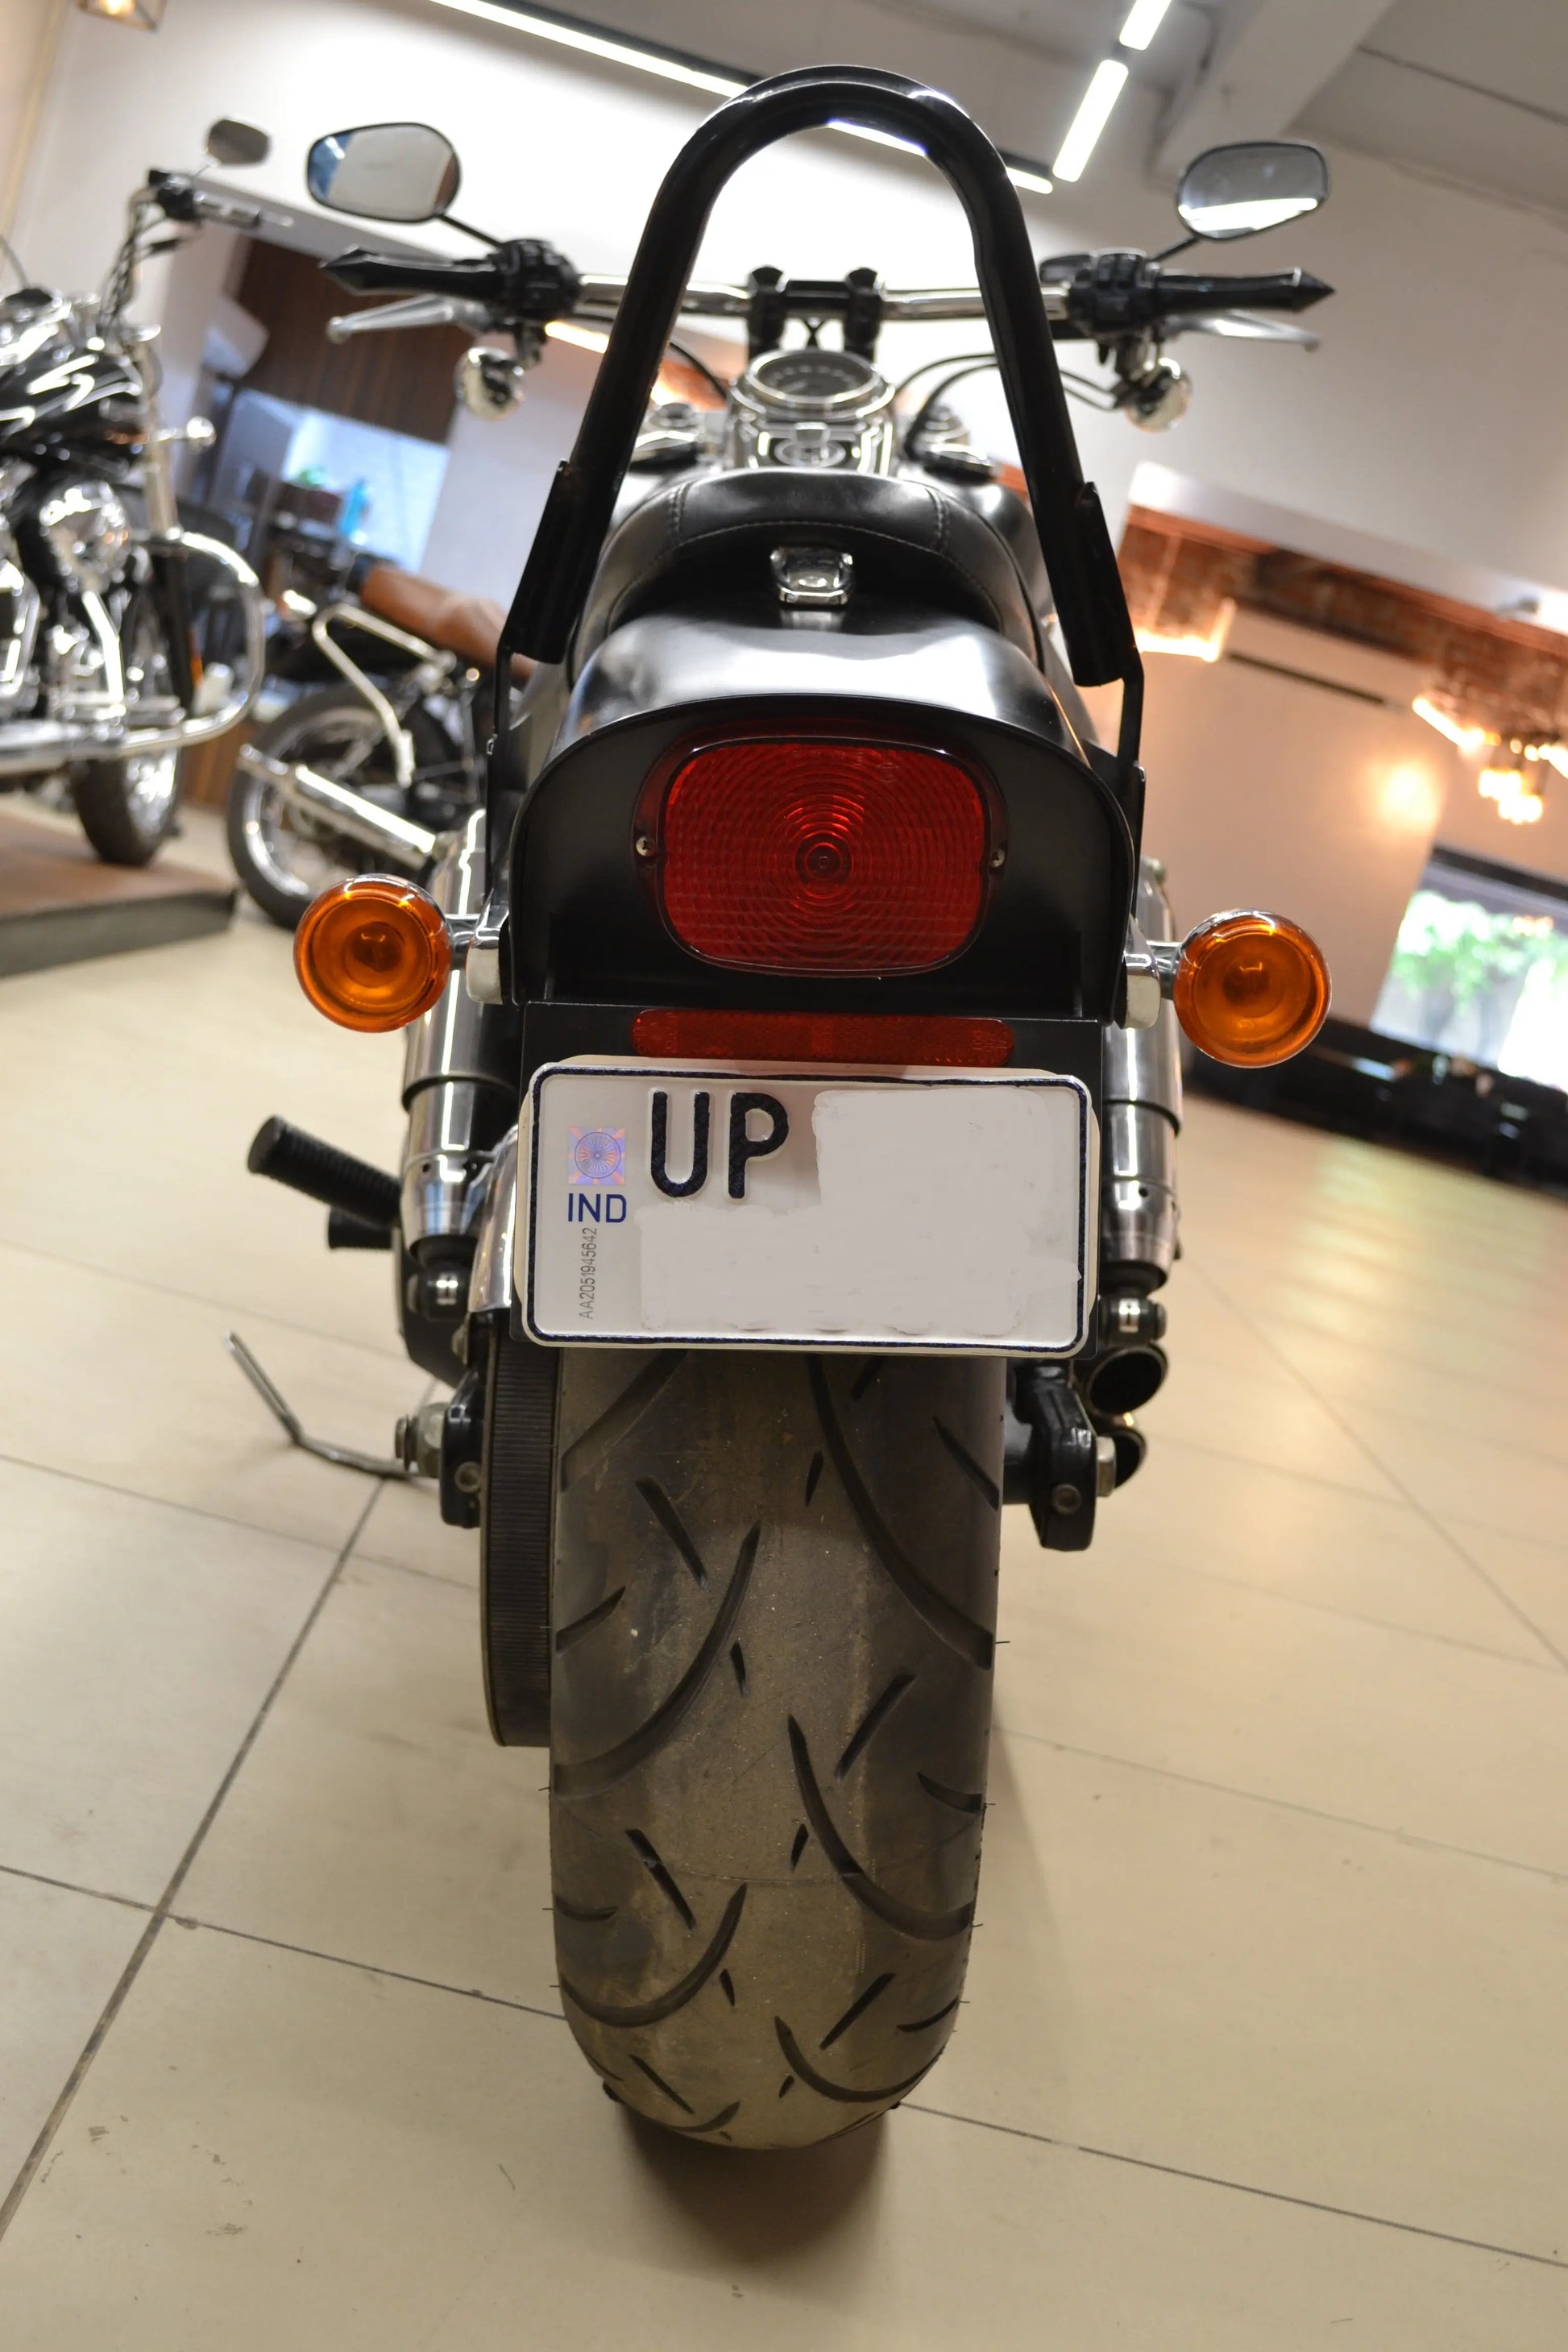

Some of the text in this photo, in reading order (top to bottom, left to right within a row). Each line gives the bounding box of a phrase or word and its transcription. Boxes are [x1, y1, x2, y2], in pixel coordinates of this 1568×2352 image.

[651, 1092, 789, 1199] UP
[568, 1193, 627, 1222] IND
[579, 1227, 597, 1320] AA2051945642
